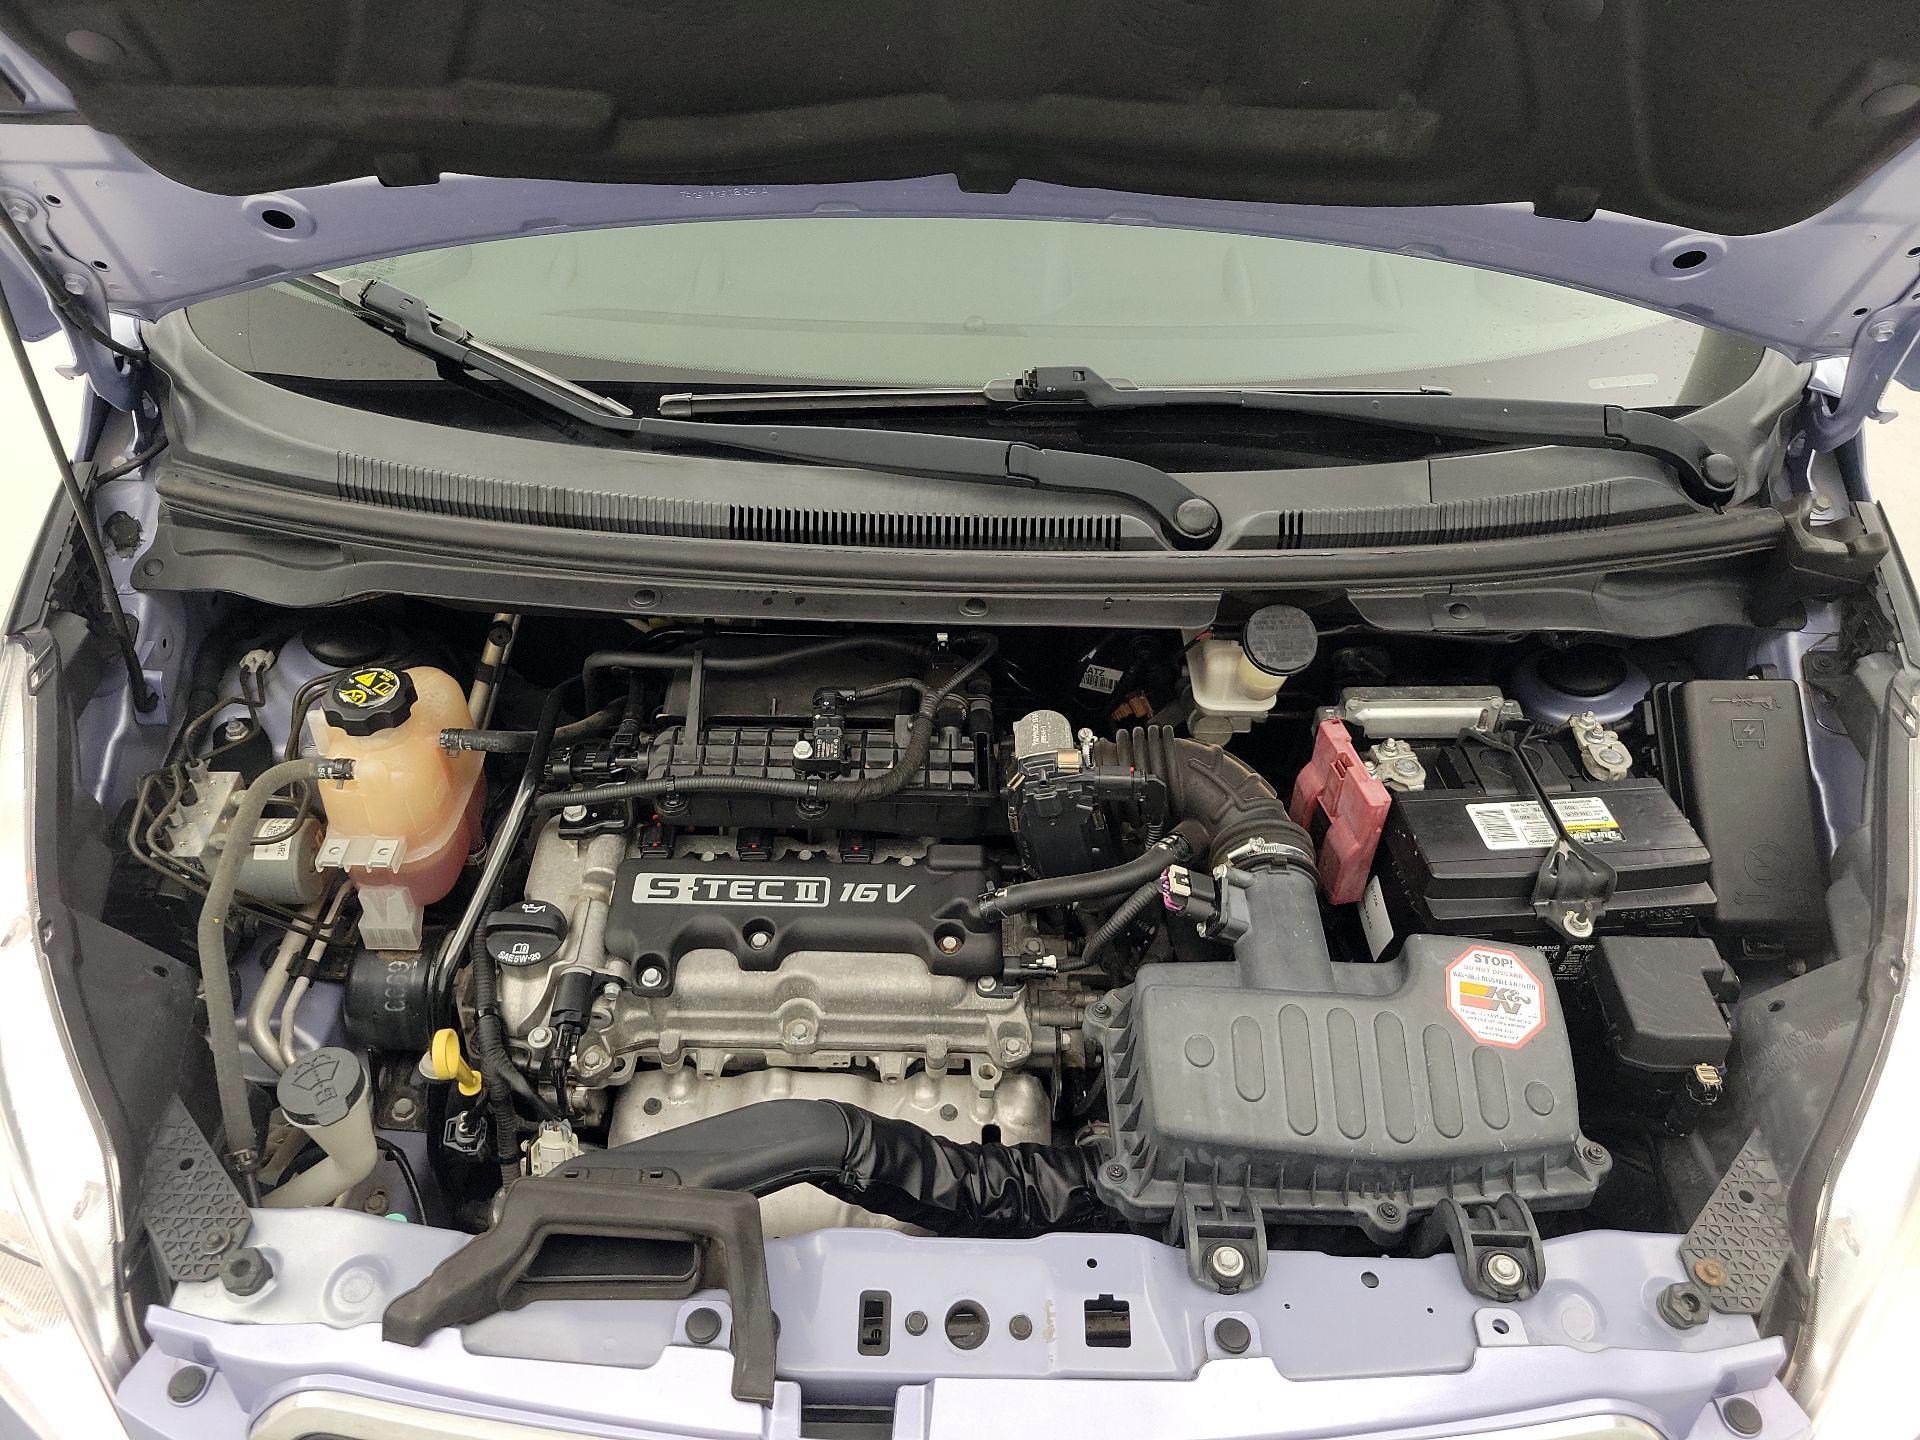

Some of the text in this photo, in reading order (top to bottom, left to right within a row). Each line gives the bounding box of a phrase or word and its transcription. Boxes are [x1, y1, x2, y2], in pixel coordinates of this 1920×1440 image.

[794, 881, 820, 902] II
[839, 882, 916, 904] 16V
[1473, 953, 1513, 969] STOP!
